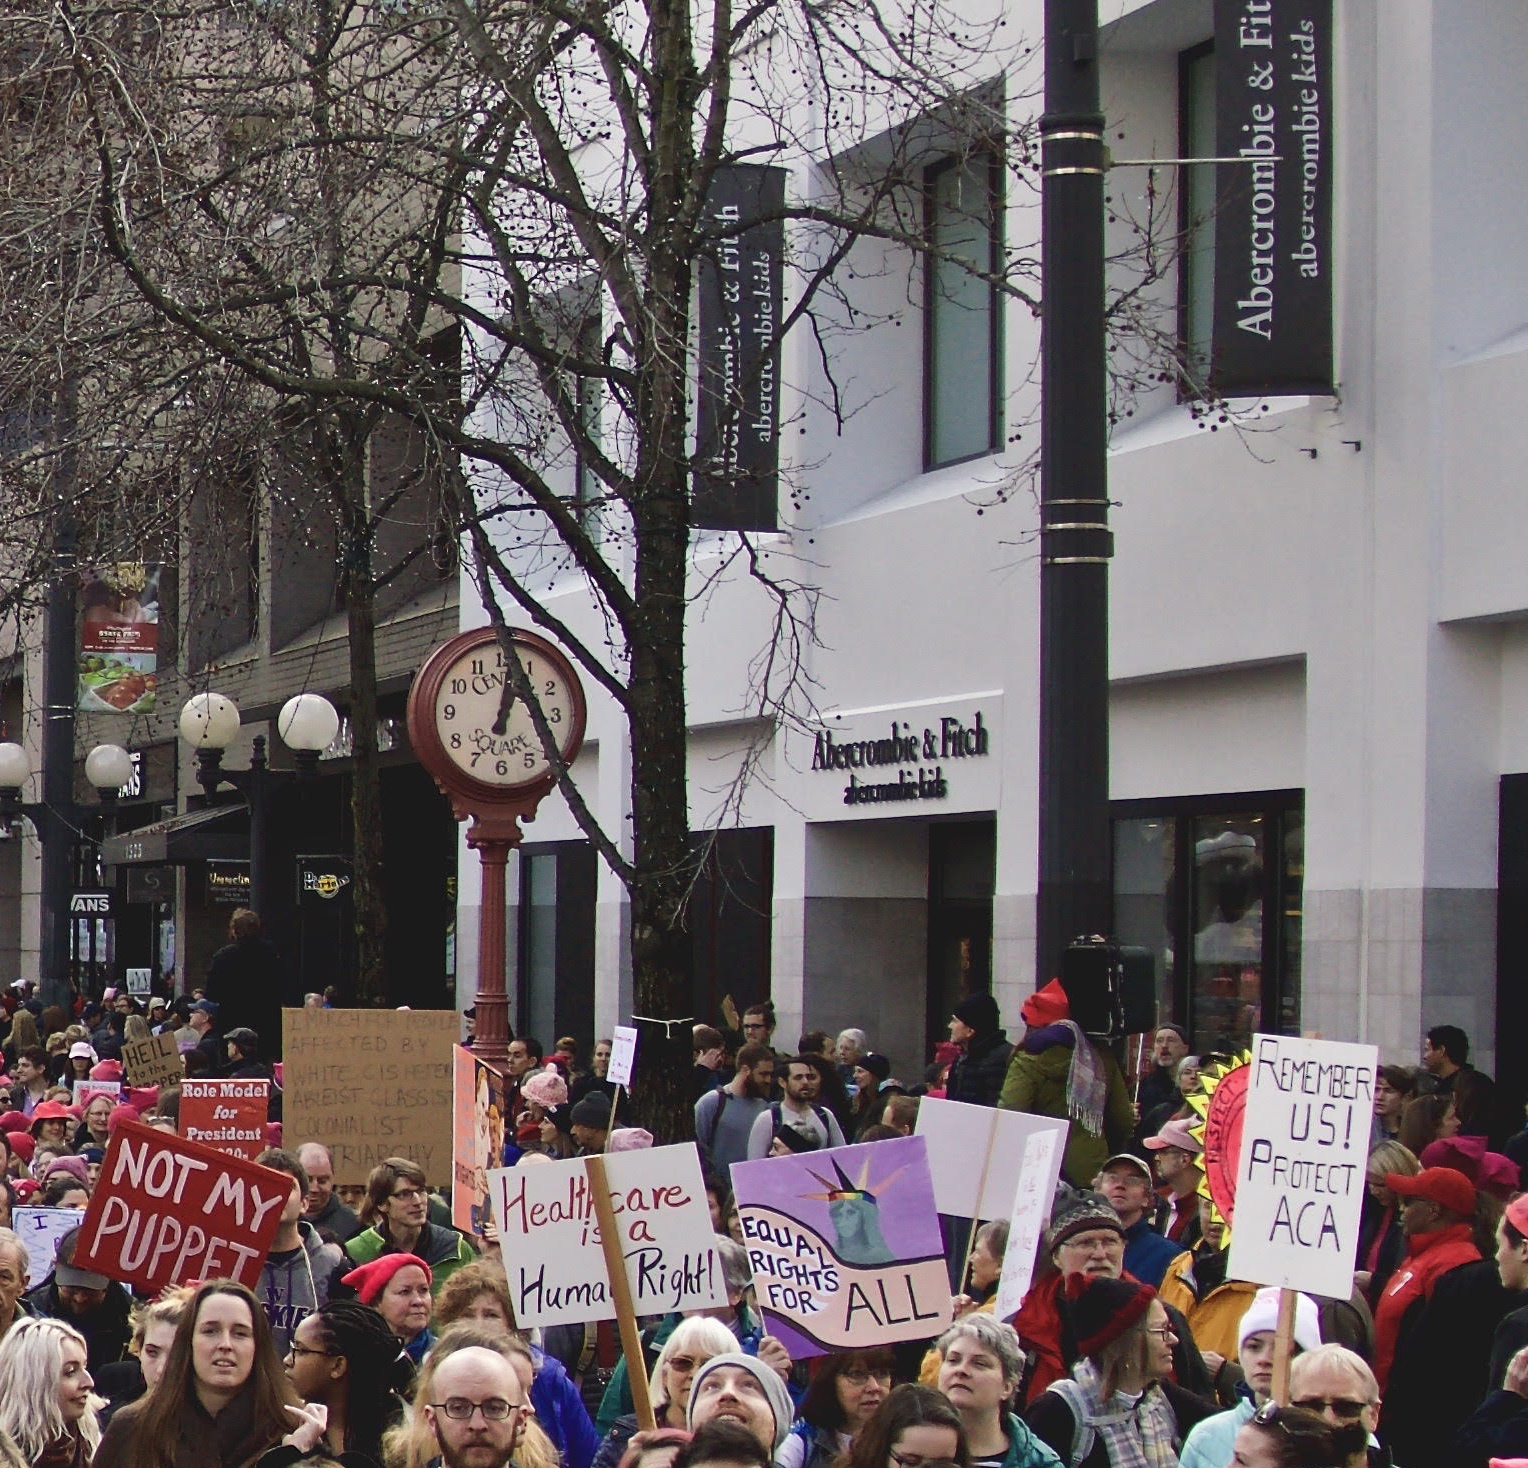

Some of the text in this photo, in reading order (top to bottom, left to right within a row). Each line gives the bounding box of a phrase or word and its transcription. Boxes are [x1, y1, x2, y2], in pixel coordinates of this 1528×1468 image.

[1290, 19, 1319, 279] abercrombie kids
[1237, 61, 1275, 340] Abercrombie &
[444, 704, 456, 720] 9
[550, 707, 562, 723] 3
[450, 733, 462, 749] 8
[468, 728, 532, 756] SQUARE
[524, 752, 536, 768] 5
[811, 711, 988, 771] Abercrombie & Fitch
[496, 760, 508, 775] 6
[126, 1039, 172, 1068] HEIL
[1256, 1039, 1372, 1102] REMEMBER
[182, 1083, 268, 1098] Role Model
[213, 1105, 237, 1120] for
[186, 1127, 261, 1141] President
[1290, 1103, 1353, 1150] US!
[111, 1137, 283, 1233] NOT MY
[1248, 1139, 1357, 1196] PROTECT
[89, 1195, 260, 1286] PUPPET
[581, 1219, 656, 1246] is a
[741, 1216, 834, 1270] EQUAL
[1269, 1195, 1341, 1252] ACA
[624, 1248, 715, 1308] Right!
[749, 1250, 840, 1292] RIGHTS
[767, 1274, 939, 1332] FOR ALL
